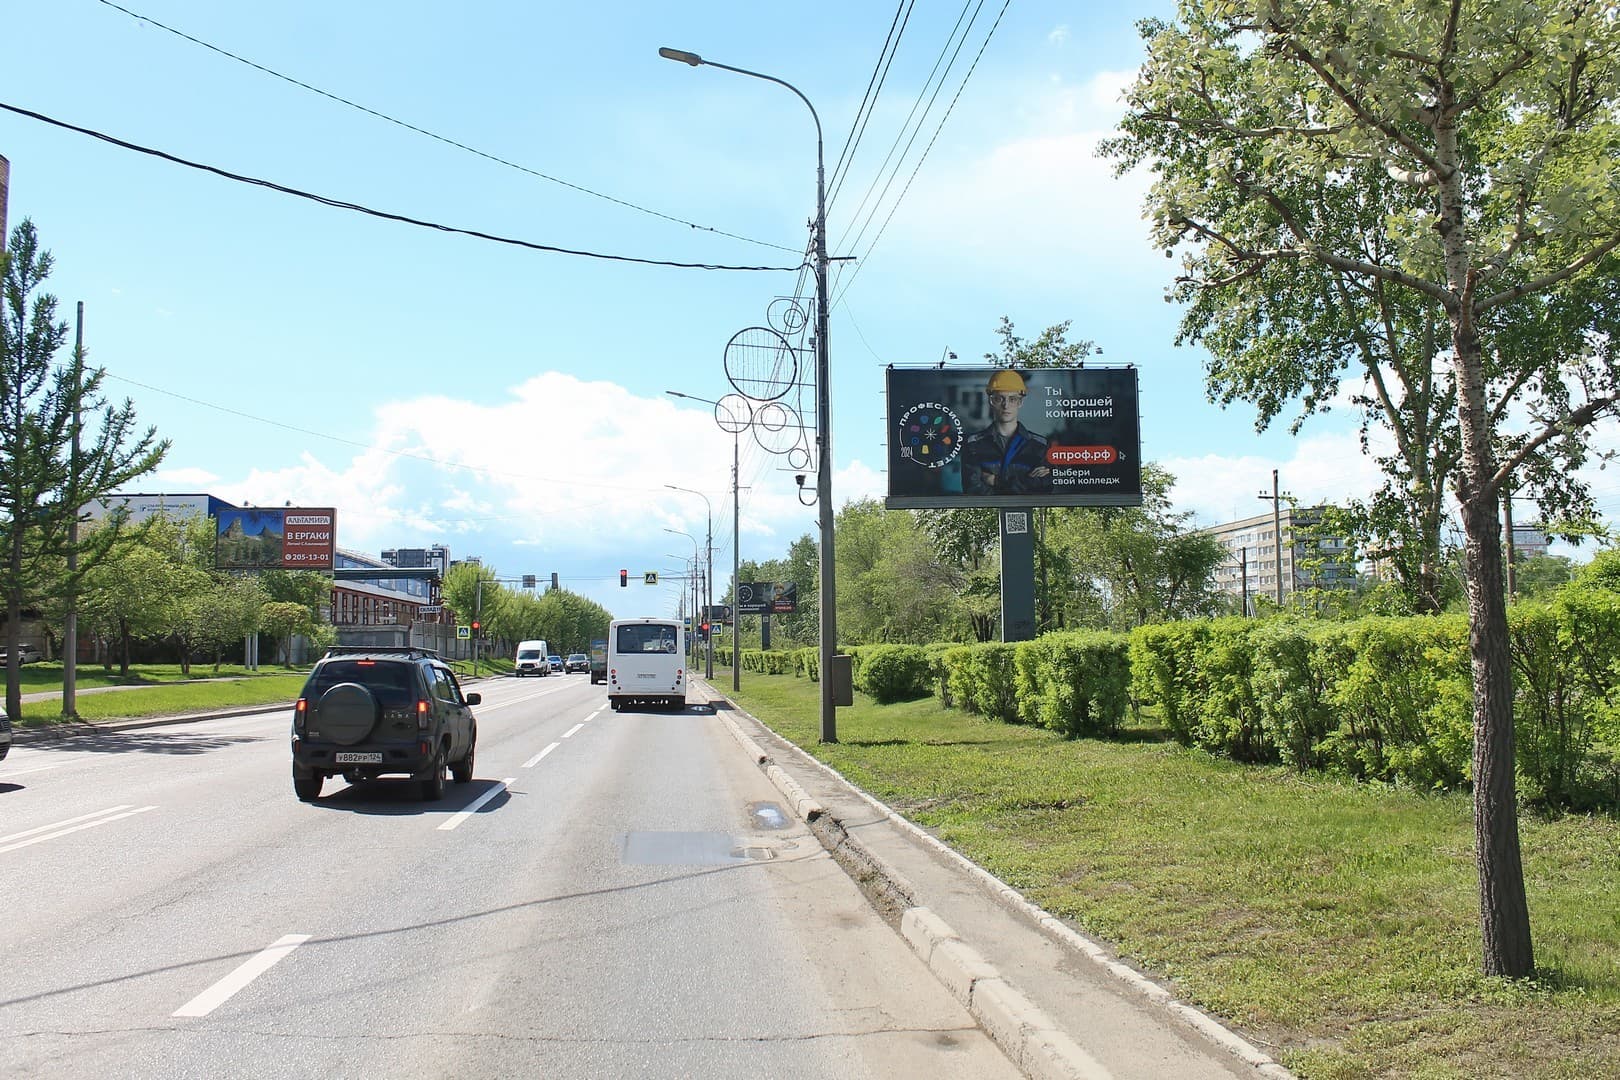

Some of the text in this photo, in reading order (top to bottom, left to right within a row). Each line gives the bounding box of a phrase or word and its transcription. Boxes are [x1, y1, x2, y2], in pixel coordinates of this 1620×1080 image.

[1044, 386, 1062, 396] Ты
[1045, 396, 1112, 408] в хорошей
[1045, 407, 1113, 418] компании!
[899, 402, 964, 468] ПРОФЕССИОНАЛИТЕТ
[900, 446, 913, 458] 2024
[1052, 449, 1111, 462] япроф.рф
[1052, 468, 1090, 477] Выбери
[1052, 476, 1121, 485] свой колледж
[287, 532, 329, 540] В ЕРГАКИ
[292, 553, 329, 561] 205-13-01
